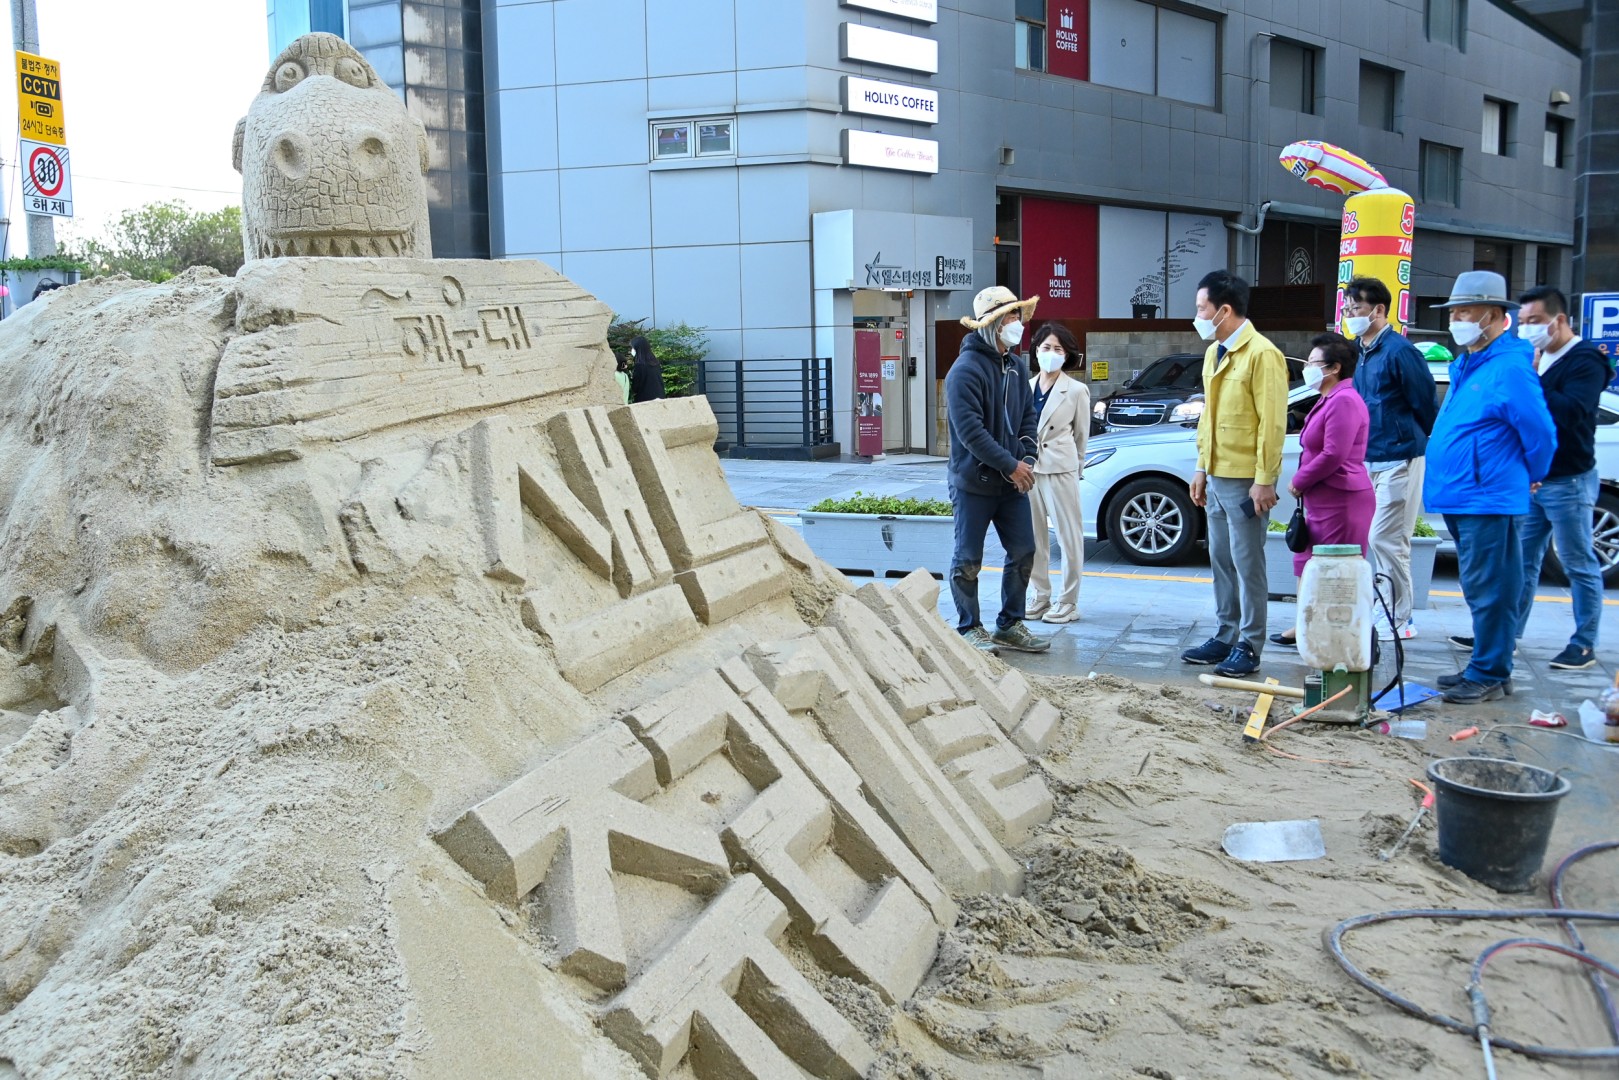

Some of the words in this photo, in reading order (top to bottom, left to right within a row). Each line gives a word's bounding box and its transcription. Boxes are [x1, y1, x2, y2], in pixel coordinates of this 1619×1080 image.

[1055, 30, 1077, 42] HOLLYS
[1055, 40, 1077, 52] COFFEE
[23, 76, 57, 97] CCTV
[864, 90, 899, 106] HOLLYS
[902, 96, 934, 112] COFFEE
[22, 118, 44, 134] 24시간
[897, 148, 915, 159] Coffee
[917, 151, 934, 162] Bean
[37, 158, 56, 185] 30
[944, 258, 966, 271] 피부과
[944, 272, 972, 286] 성형외과
[1049, 279, 1071, 288] HOLLYS
[1049, 289, 1071, 298] COFFEE
[361, 275, 532, 376] 해운대
[1592, 300, 1619, 338] P
